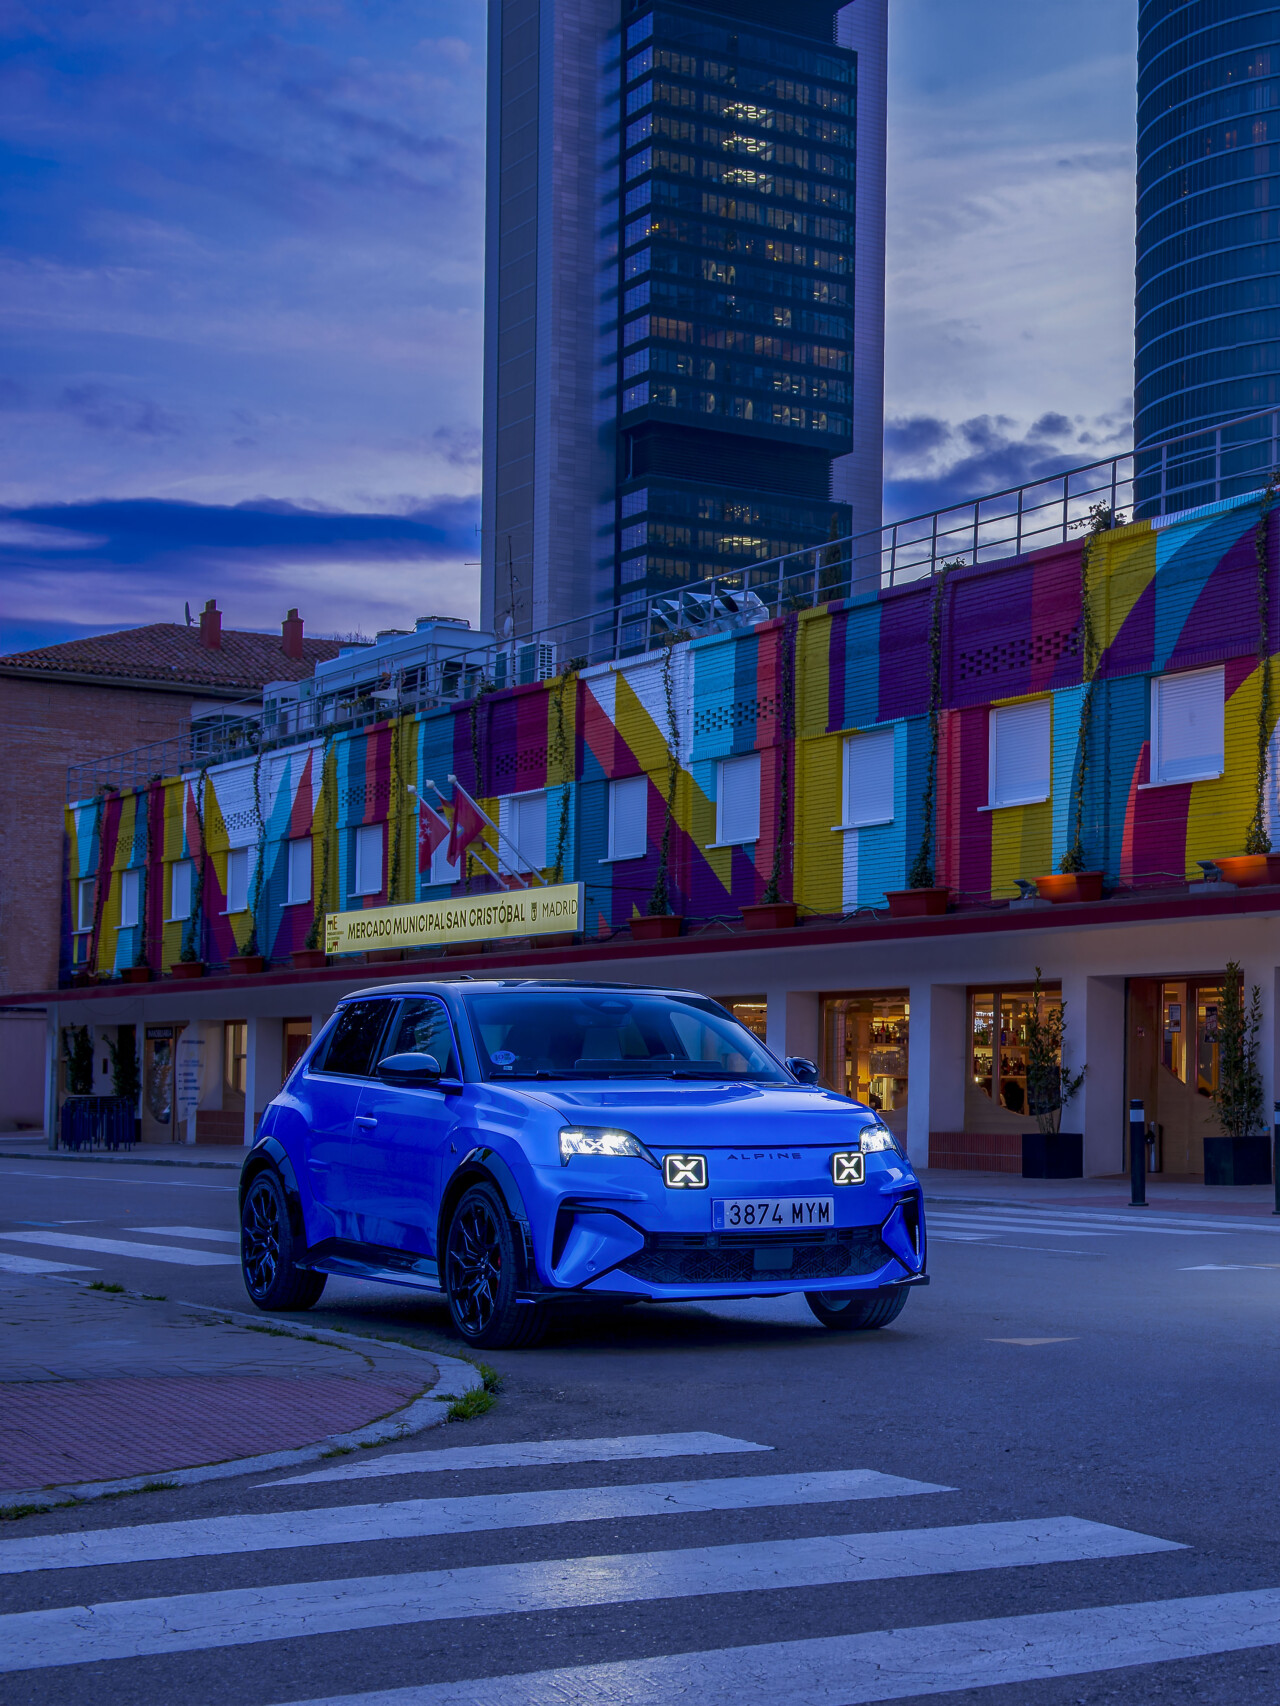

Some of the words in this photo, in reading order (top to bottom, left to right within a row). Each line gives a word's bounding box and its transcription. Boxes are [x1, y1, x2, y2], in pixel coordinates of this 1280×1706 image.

[542, 898, 579, 919] MADRID
[347, 919, 392, 940] MERCADO
[393, 912, 445, 935] MUNICIPAL
[446, 909, 467, 929] SAN
[468, 900, 525, 927] CRISTÓBAL
[727, 1152, 802, 1161] ALPINE
[729, 1203, 783, 1225] 3874
[792, 1202, 830, 1223] MYM
